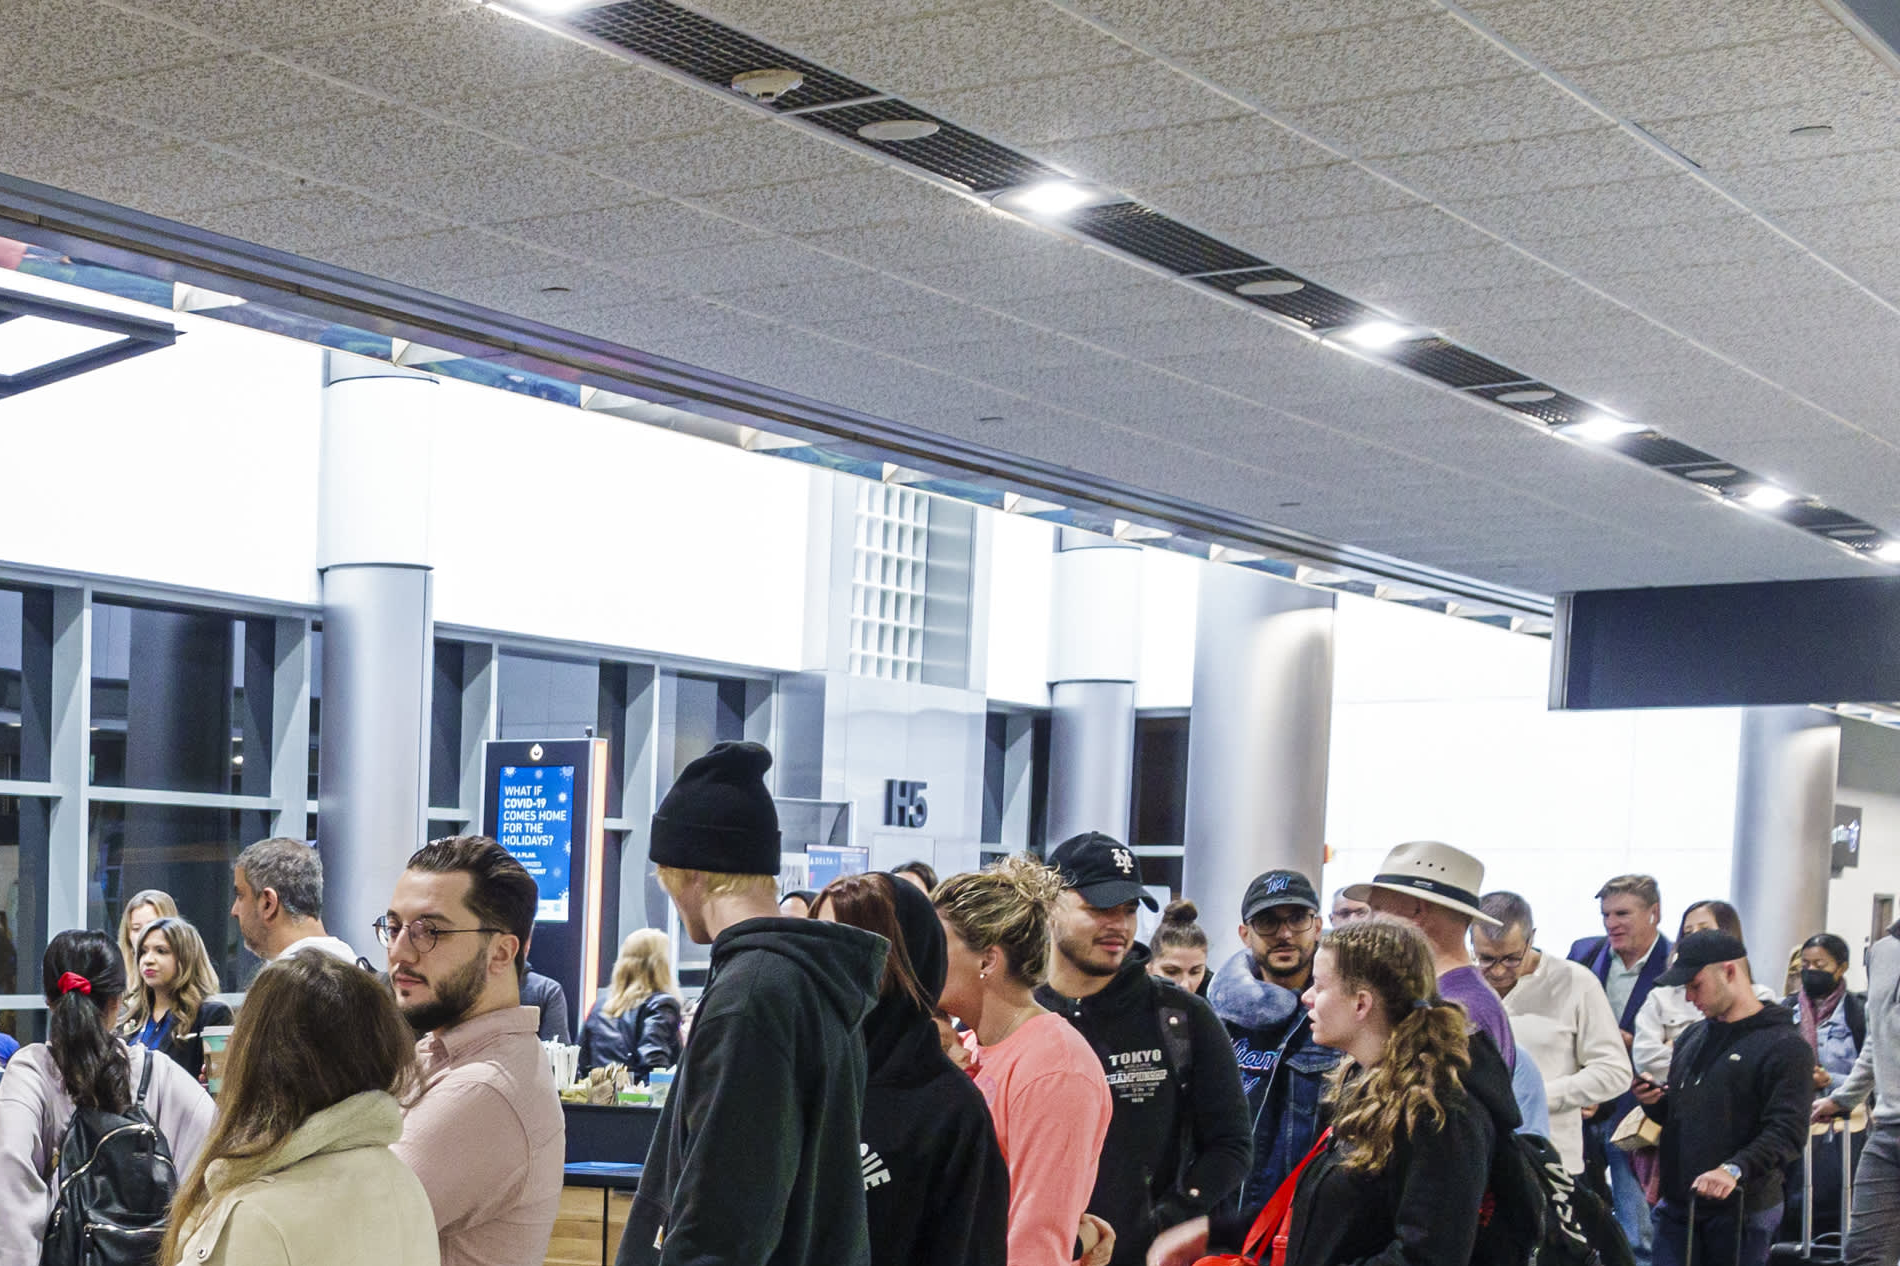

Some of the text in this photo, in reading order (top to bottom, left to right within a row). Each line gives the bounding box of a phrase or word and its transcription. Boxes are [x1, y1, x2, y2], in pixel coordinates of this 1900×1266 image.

[504, 785, 543, 796] WHAT IF
[503, 798, 547, 809] COVID-19
[884, 778, 928, 828] H5
[503, 810, 567, 821] COMES HOME
[503, 823, 544, 833] FOR THE
[502, 835, 555, 846] HOLIDAYS?
[1109, 1049, 1162, 1066] TOKYO
